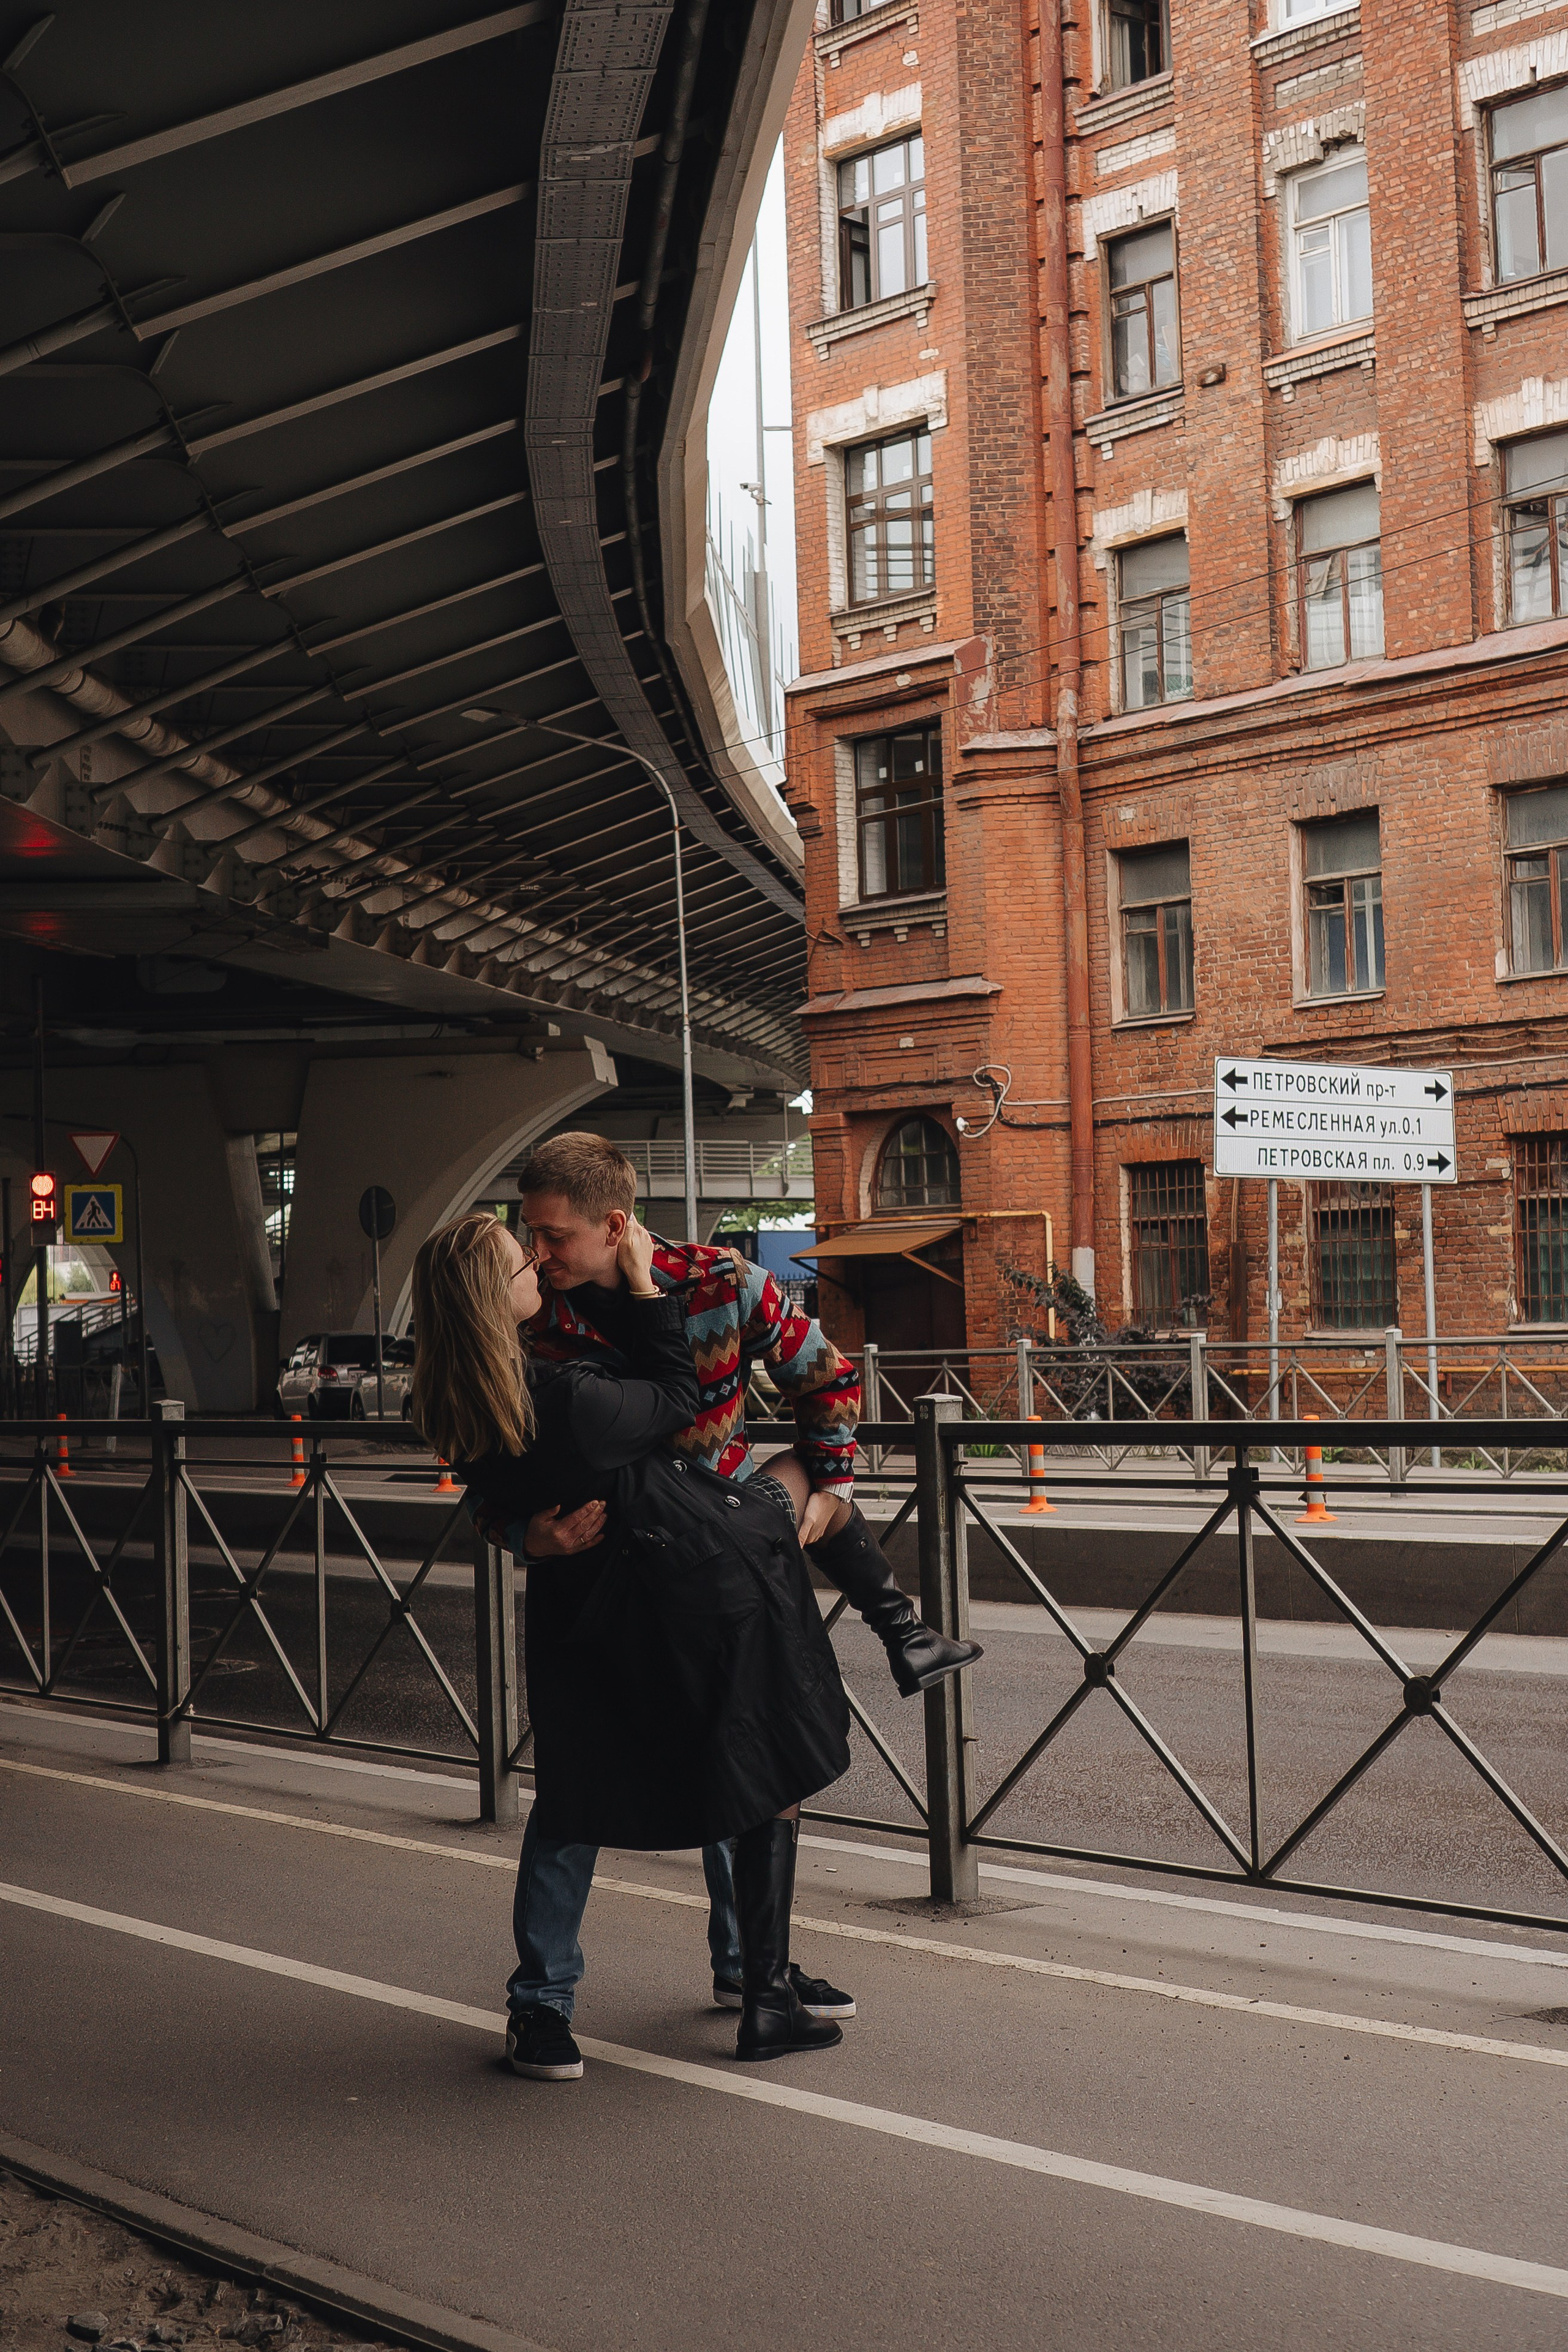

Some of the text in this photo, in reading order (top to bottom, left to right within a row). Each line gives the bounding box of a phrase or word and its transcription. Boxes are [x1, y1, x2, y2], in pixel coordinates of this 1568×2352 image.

[1253, 1072, 1396, 1101] ПЕТРОВСКИЙ пр-т
[1250, 1109, 1375, 1133] РЕМЕСЛЕННАЯ
[1258, 1147, 1424, 1171] ПЕТРОВСКАЯ пл. 0,9
[33, 1200, 54, 1219] 84
